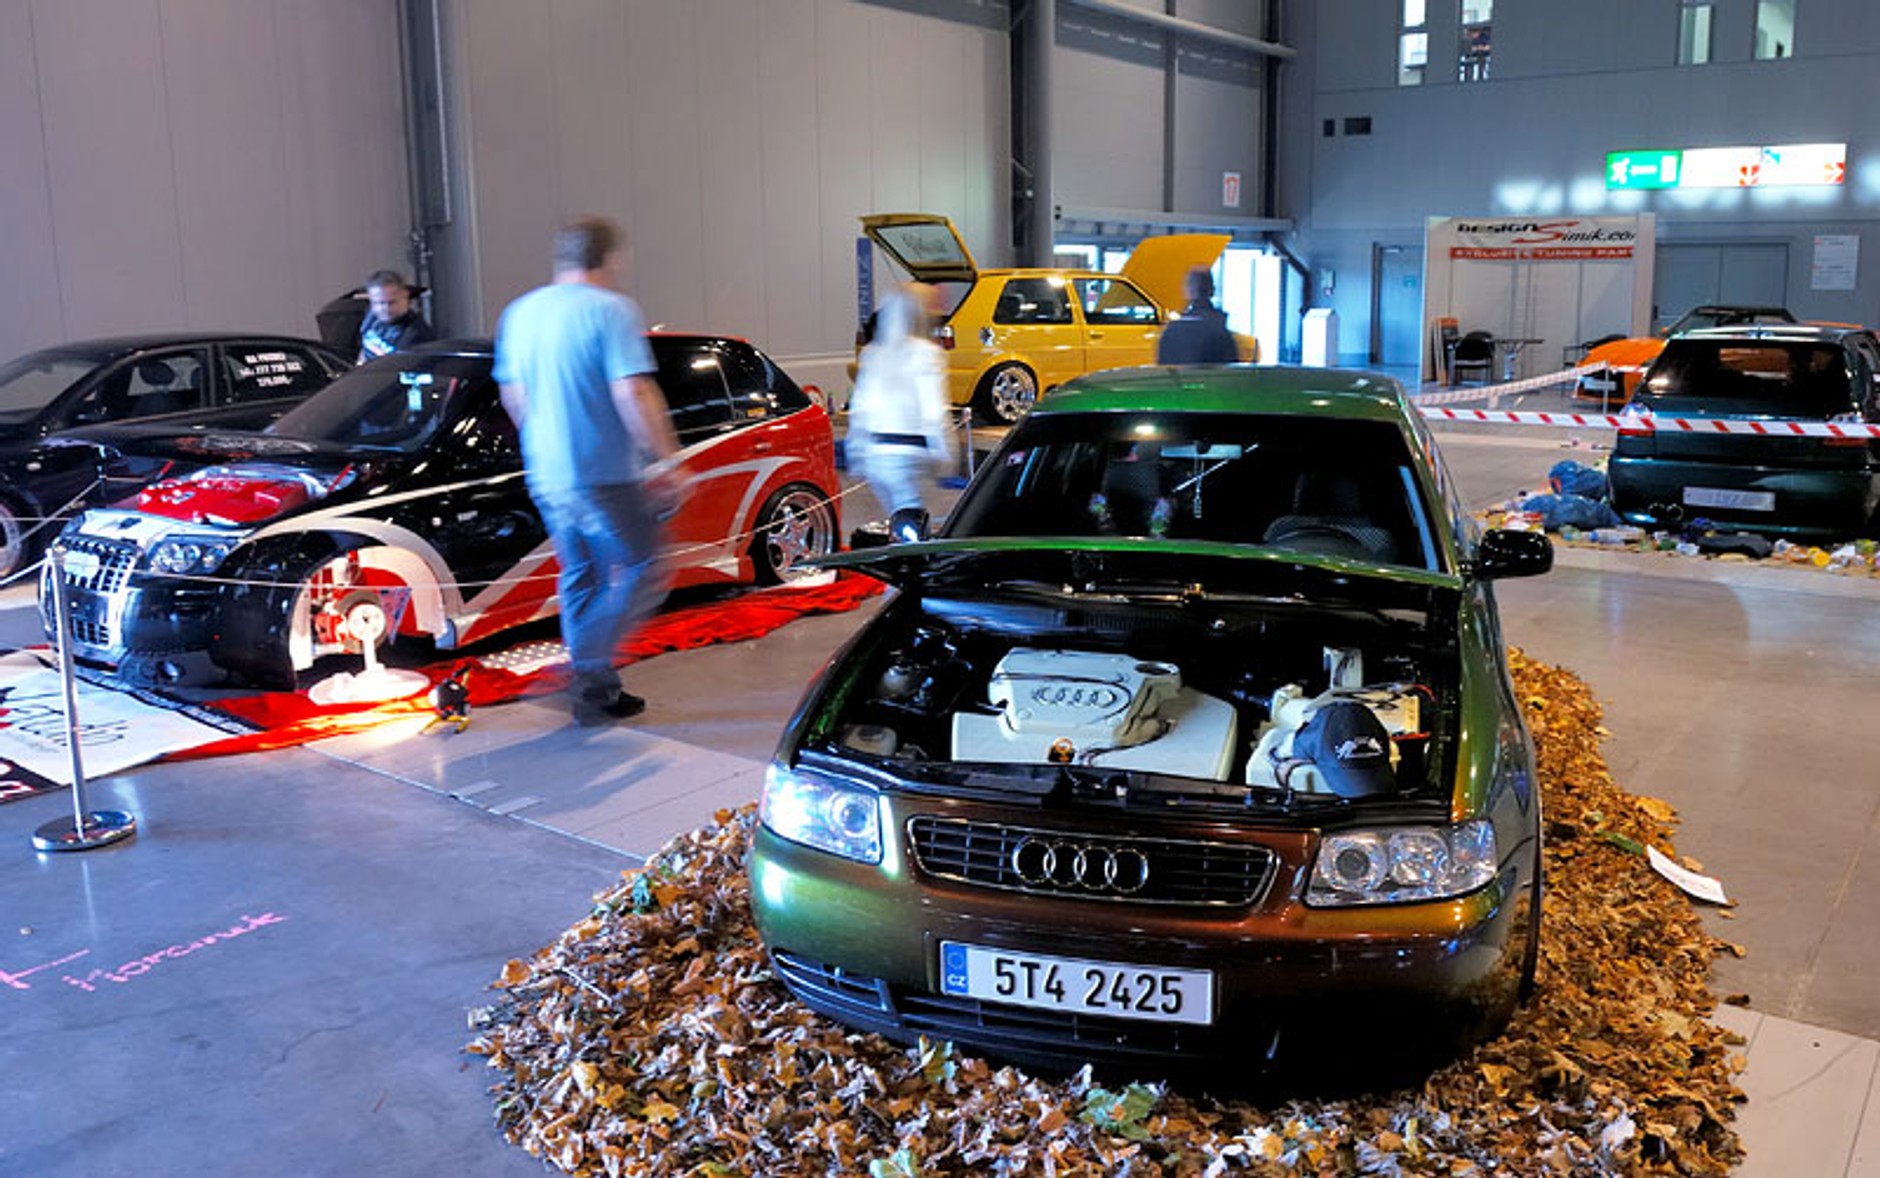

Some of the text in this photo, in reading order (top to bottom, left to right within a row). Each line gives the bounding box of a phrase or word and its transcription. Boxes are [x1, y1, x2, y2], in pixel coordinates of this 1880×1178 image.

[946, 973, 968, 989] CZ
[995, 957, 1183, 1015] 5T4 2425
